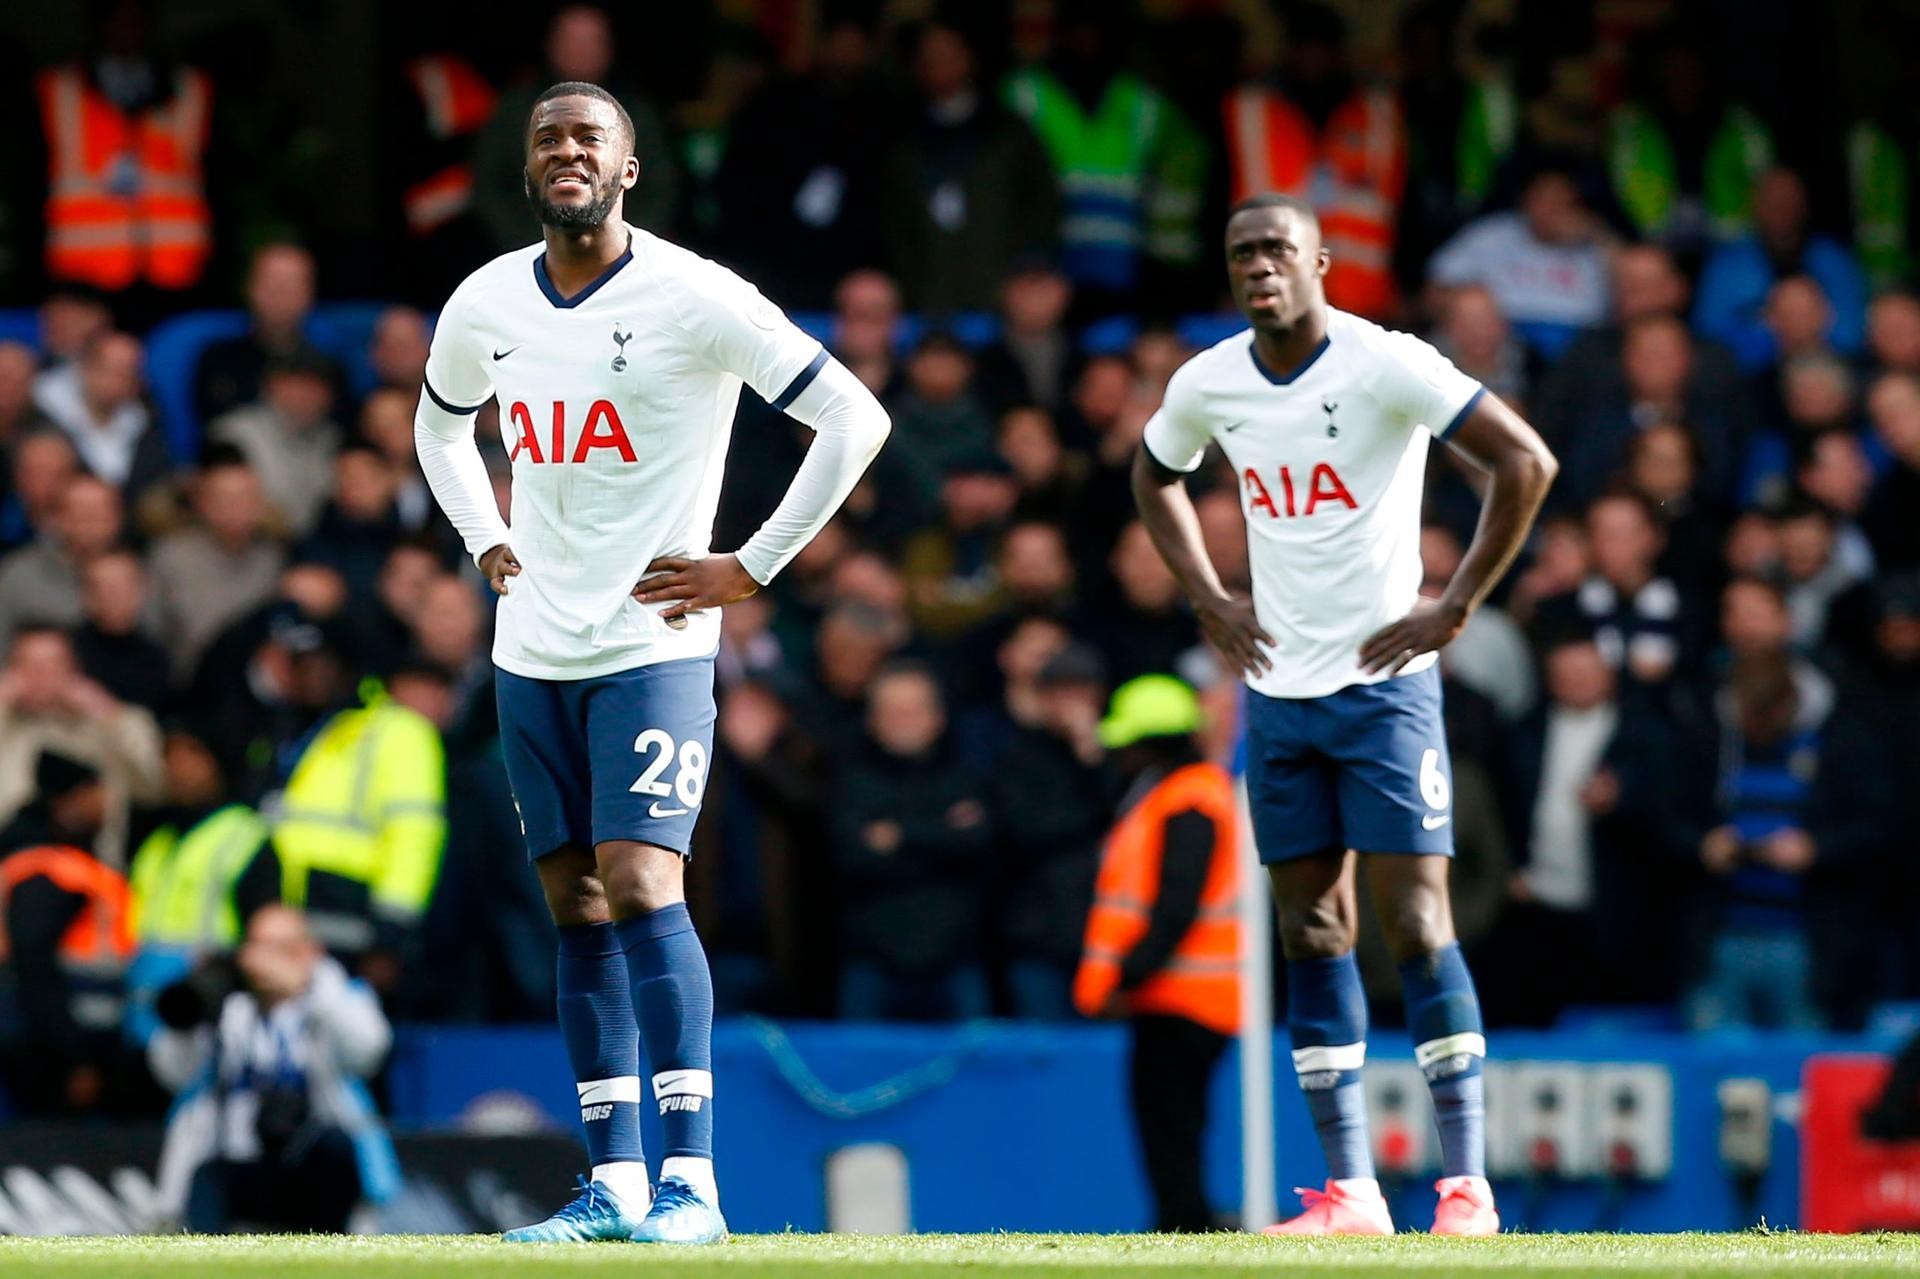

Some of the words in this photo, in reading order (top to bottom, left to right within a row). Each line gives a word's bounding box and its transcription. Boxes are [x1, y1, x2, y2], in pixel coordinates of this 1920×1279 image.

[510, 400, 638, 463] AIA
[1244, 462, 1358, 518] AIA
[628, 728, 707, 809] 28
[1419, 748, 1450, 811] 6
[659, 1095, 702, 1115] SPURS
